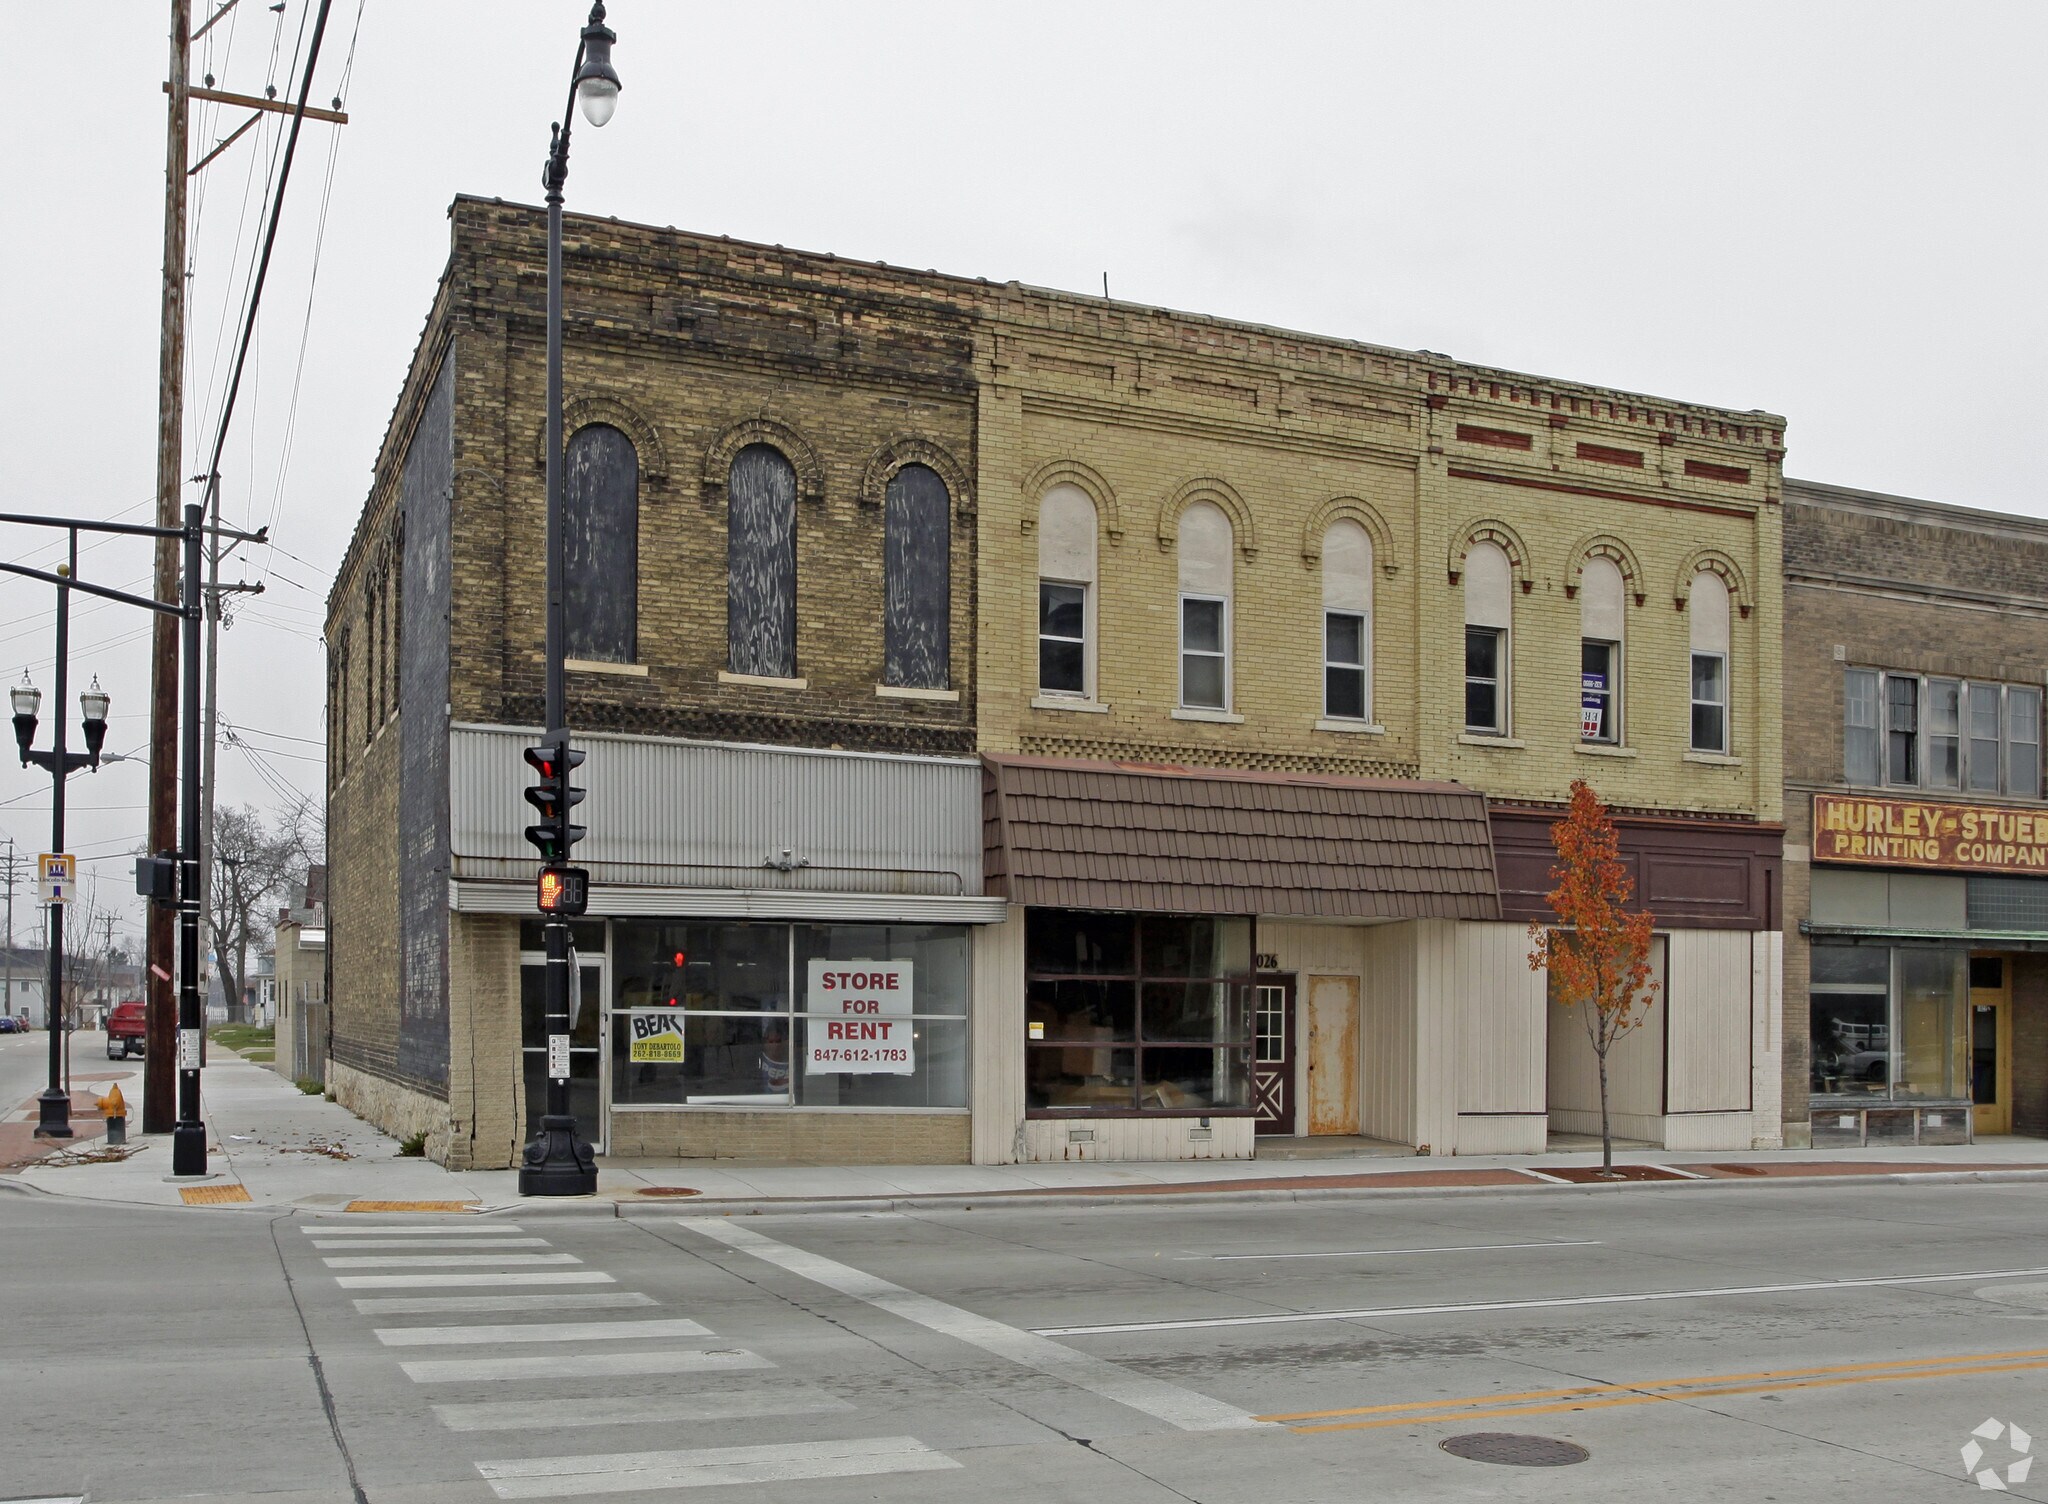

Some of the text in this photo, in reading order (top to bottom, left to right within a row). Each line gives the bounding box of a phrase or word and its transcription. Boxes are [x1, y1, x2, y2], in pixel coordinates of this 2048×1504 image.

[1583, 712, 1599, 721] ER
[1834, 834, 2048, 866] PRINTING COMPAN
[1256, 954, 1278, 969] 026
[822, 972, 899, 990] STORE
[842, 1000, 879, 1014] FOR
[827, 1022, 893, 1040] RENT
